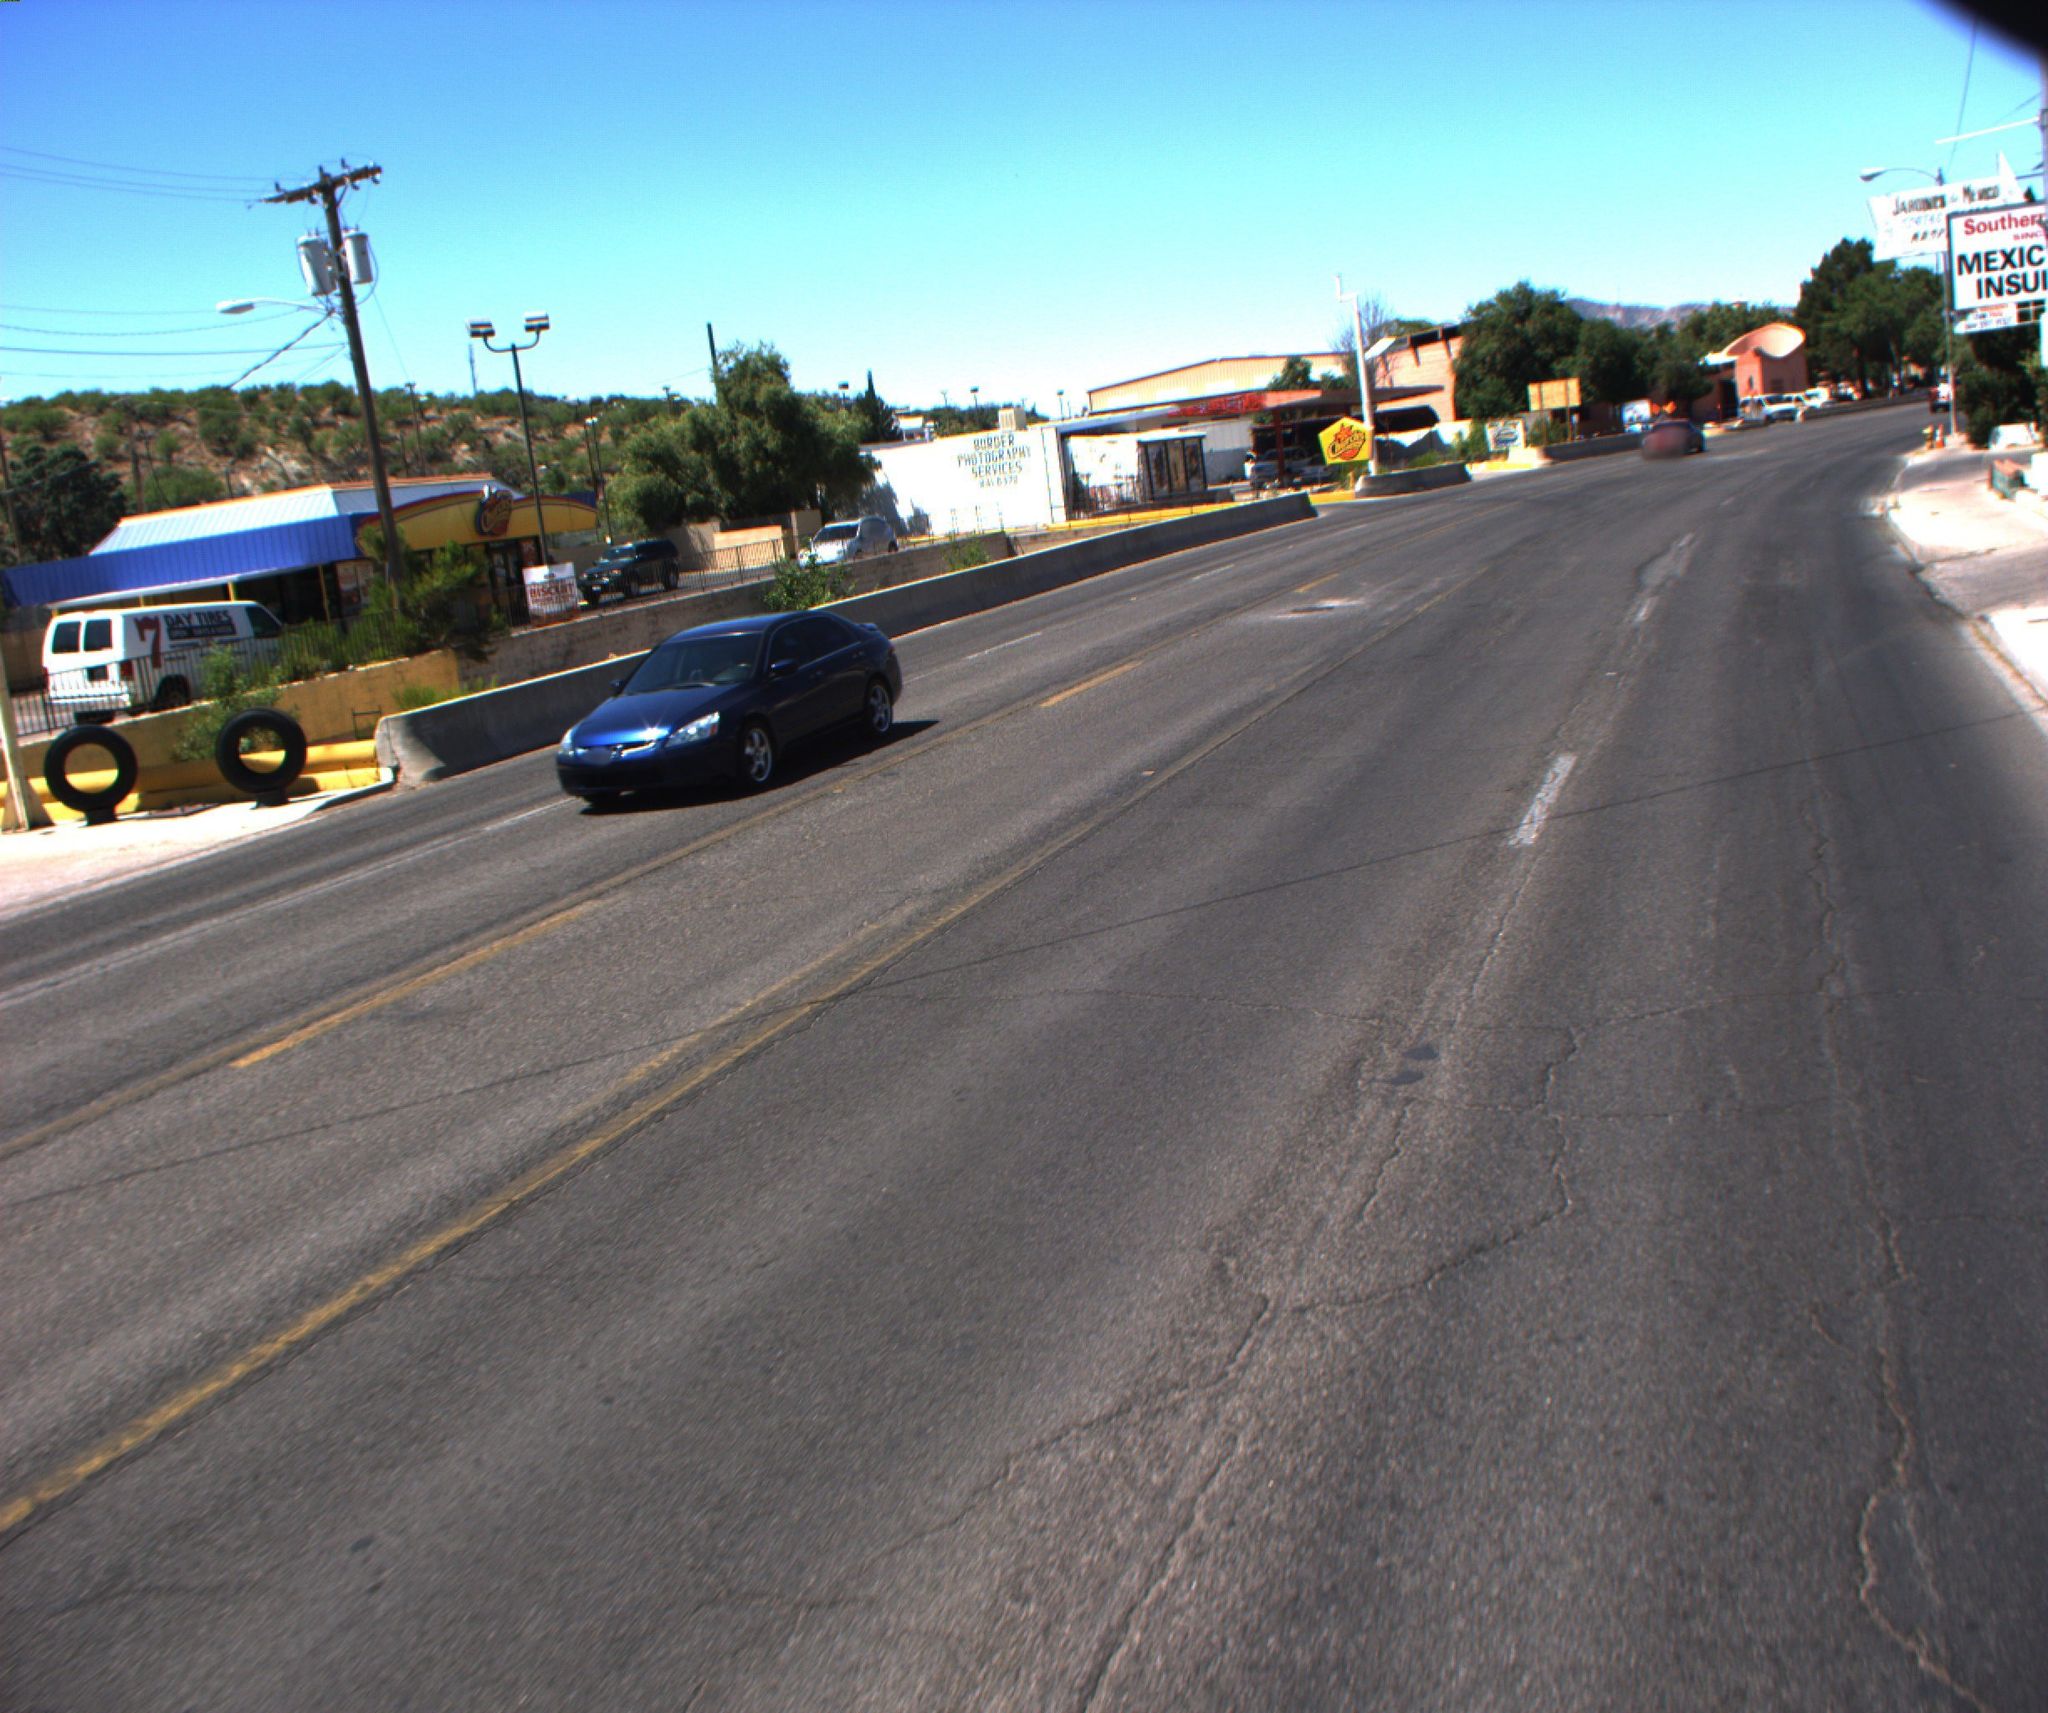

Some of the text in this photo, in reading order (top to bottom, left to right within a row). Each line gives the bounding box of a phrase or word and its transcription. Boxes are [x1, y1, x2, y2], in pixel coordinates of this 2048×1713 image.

[957, 446, 1031, 468] PHOTOGRAPHY
[972, 460, 1022, 477] SERVICES
[164, 614, 192, 626] DAY
[195, 610, 231, 625] TIRES
